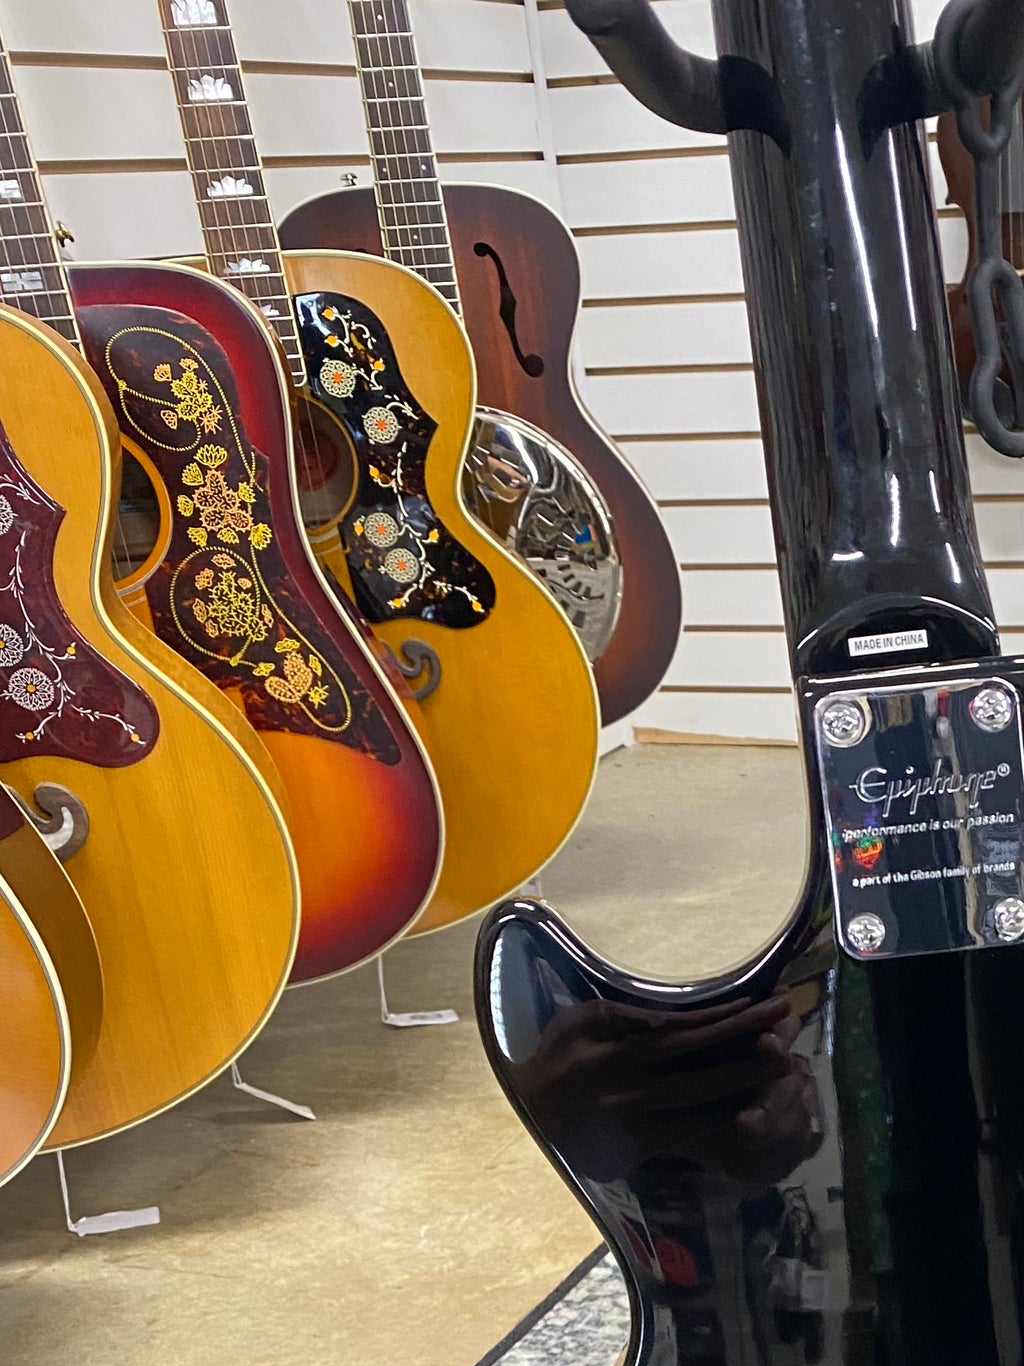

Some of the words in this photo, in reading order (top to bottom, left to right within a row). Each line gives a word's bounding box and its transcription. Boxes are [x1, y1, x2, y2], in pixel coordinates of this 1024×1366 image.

[854, 638, 882, 651] MADE
[883, 637, 893, 648] IN
[895, 633, 925, 646] CHINA
[842, 822, 928, 843] performance
[929, 819, 940, 831] is
[942, 819, 964, 830] our
[967, 811, 1015, 831] passion
[852, 878, 860, 888] a
[860, 875, 881, 889] part
[882, 872, 892, 884] of
[893, 871, 909, 883] the
[910, 869, 941, 881] Gibson
[942, 866, 969, 879] family
[972, 863, 981, 875] of
[983, 861, 1016, 874] brands
